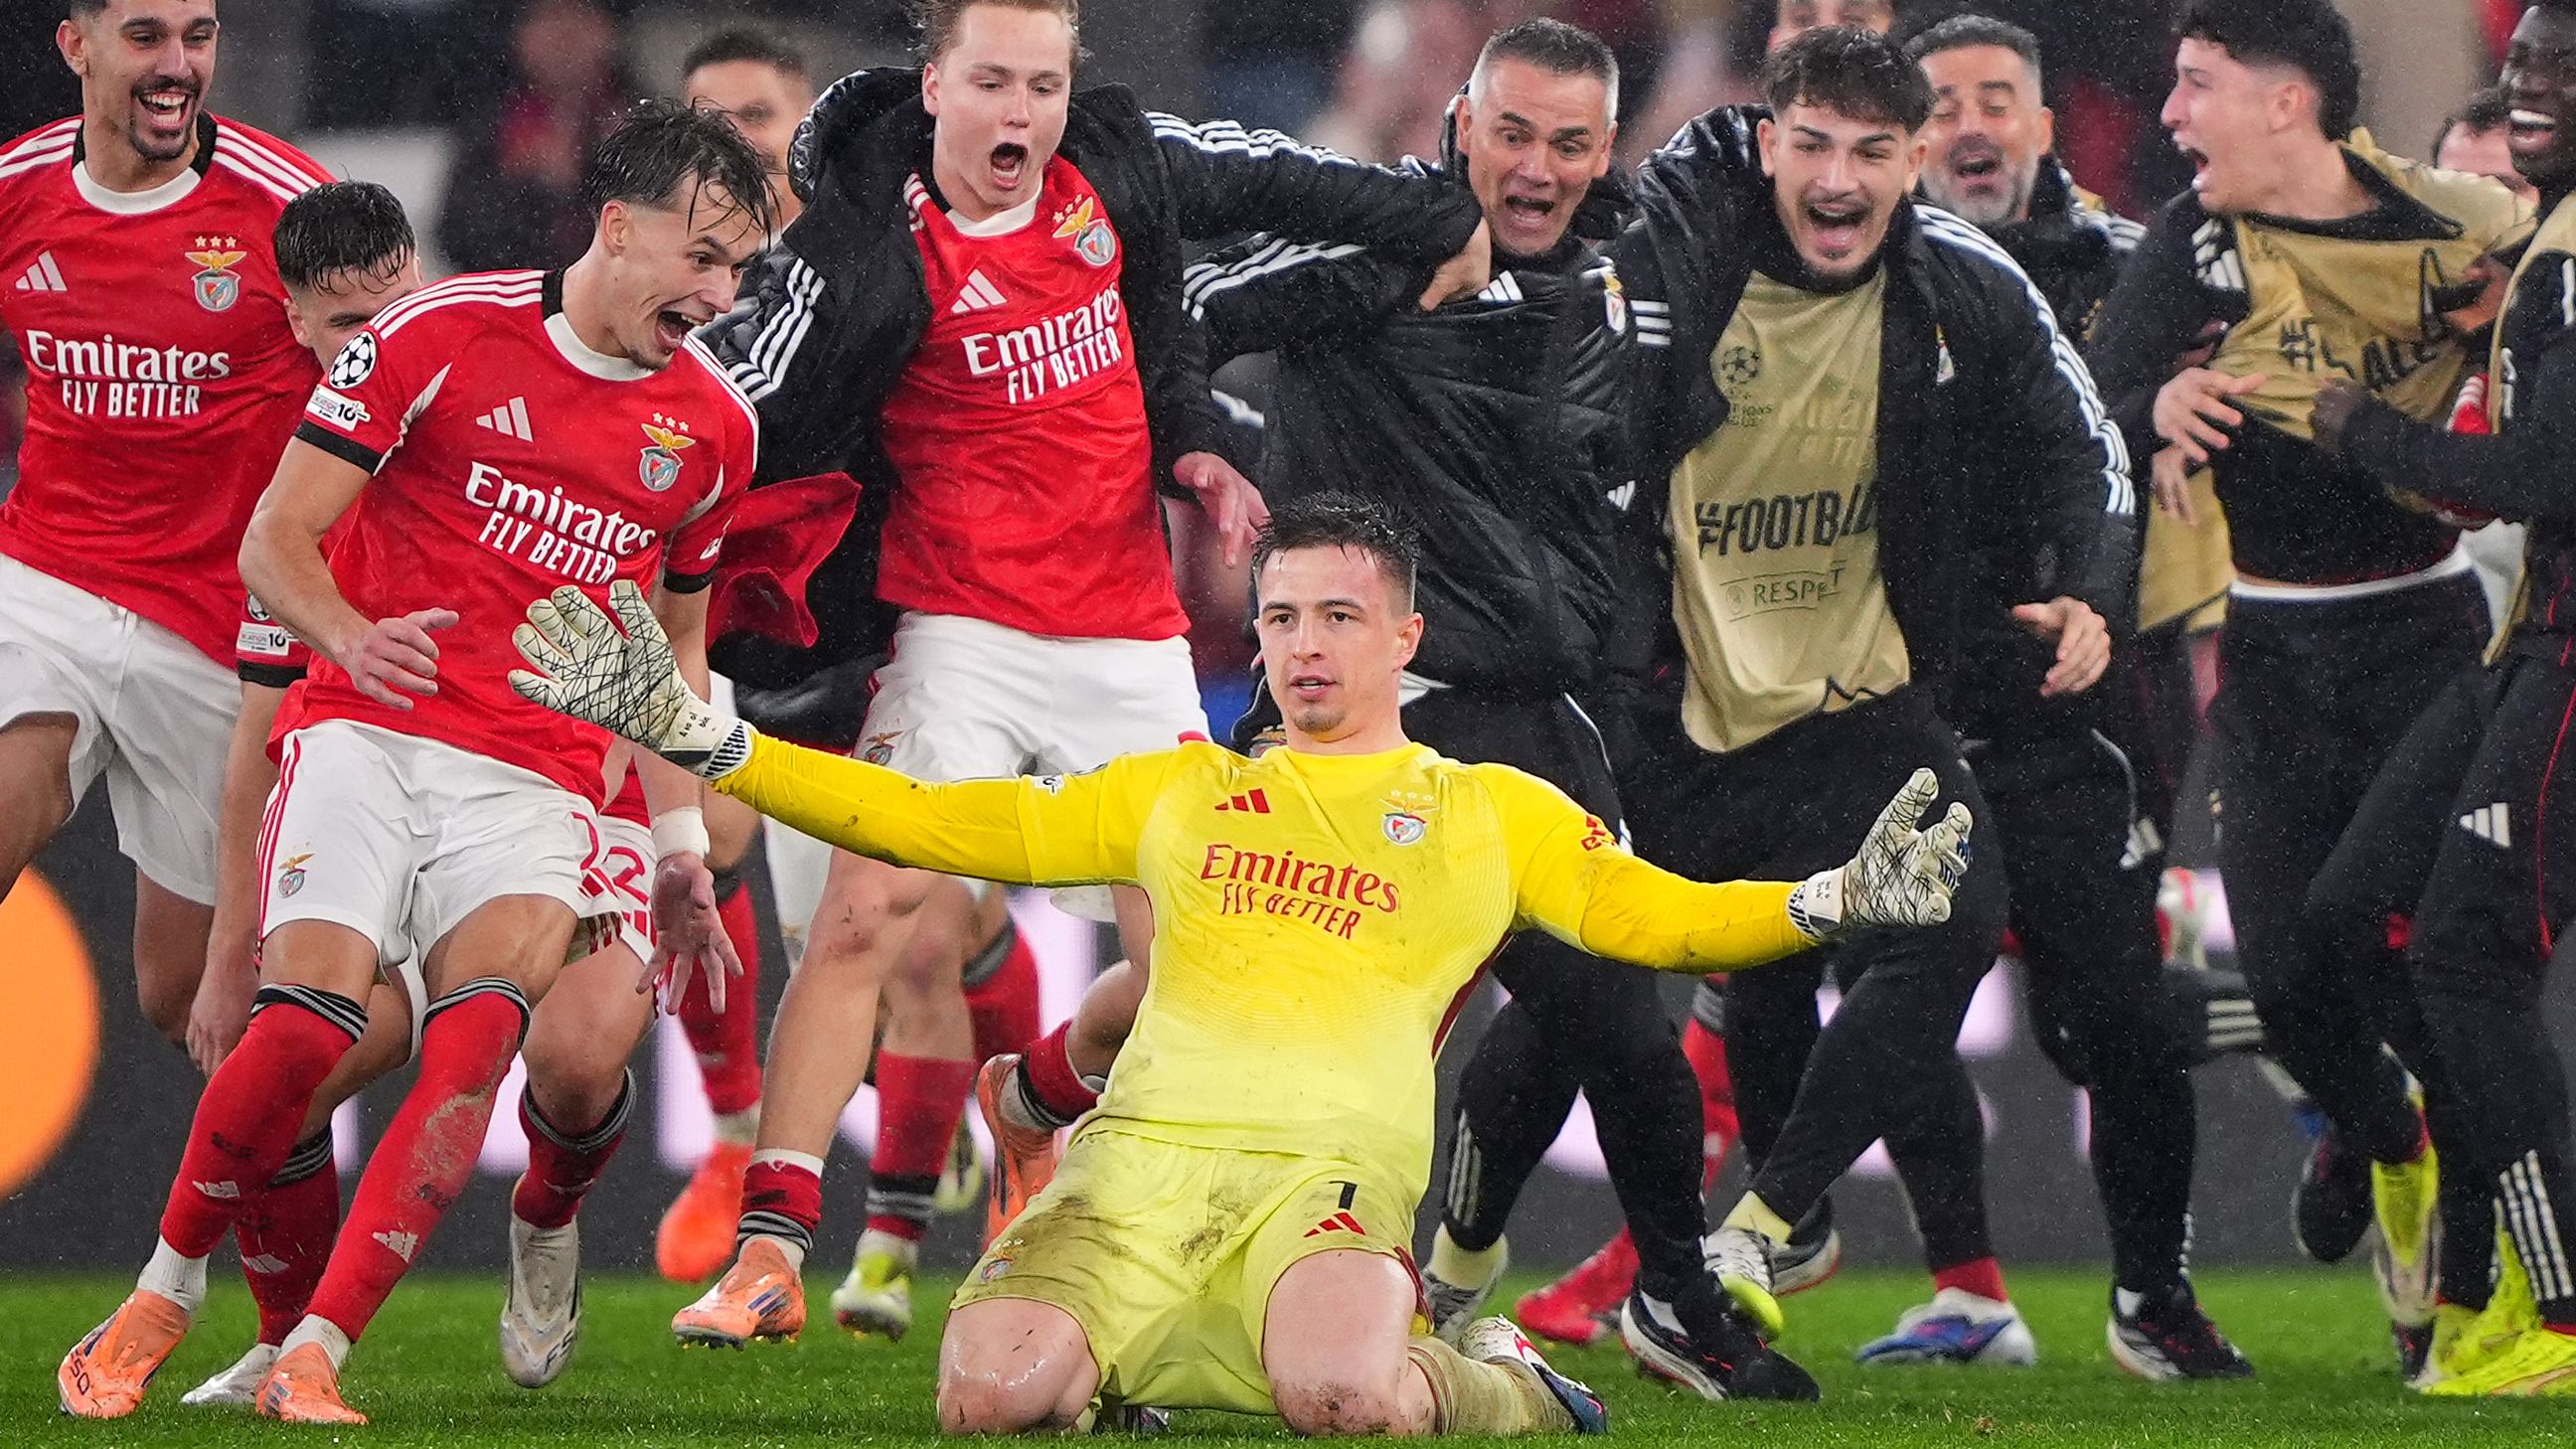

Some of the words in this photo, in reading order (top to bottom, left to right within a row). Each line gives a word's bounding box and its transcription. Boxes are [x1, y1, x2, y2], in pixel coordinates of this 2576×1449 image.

[26, 329, 231, 383] Emirates
[961, 281, 1121, 376] Emirates
[62, 379, 98, 415] FLY
[107, 382, 200, 417] BETTER
[1007, 360, 1045, 404] FLY
[1048, 325, 1122, 390] BETTER
[465, 460, 656, 556] Emirates
[478, 510, 533, 555] FLY
[528, 530, 617, 584] BETTER
[1200, 844, 1400, 913] Emirates
[1221, 883, 1262, 915] FLY
[1265, 891, 1362, 940] BETTER
